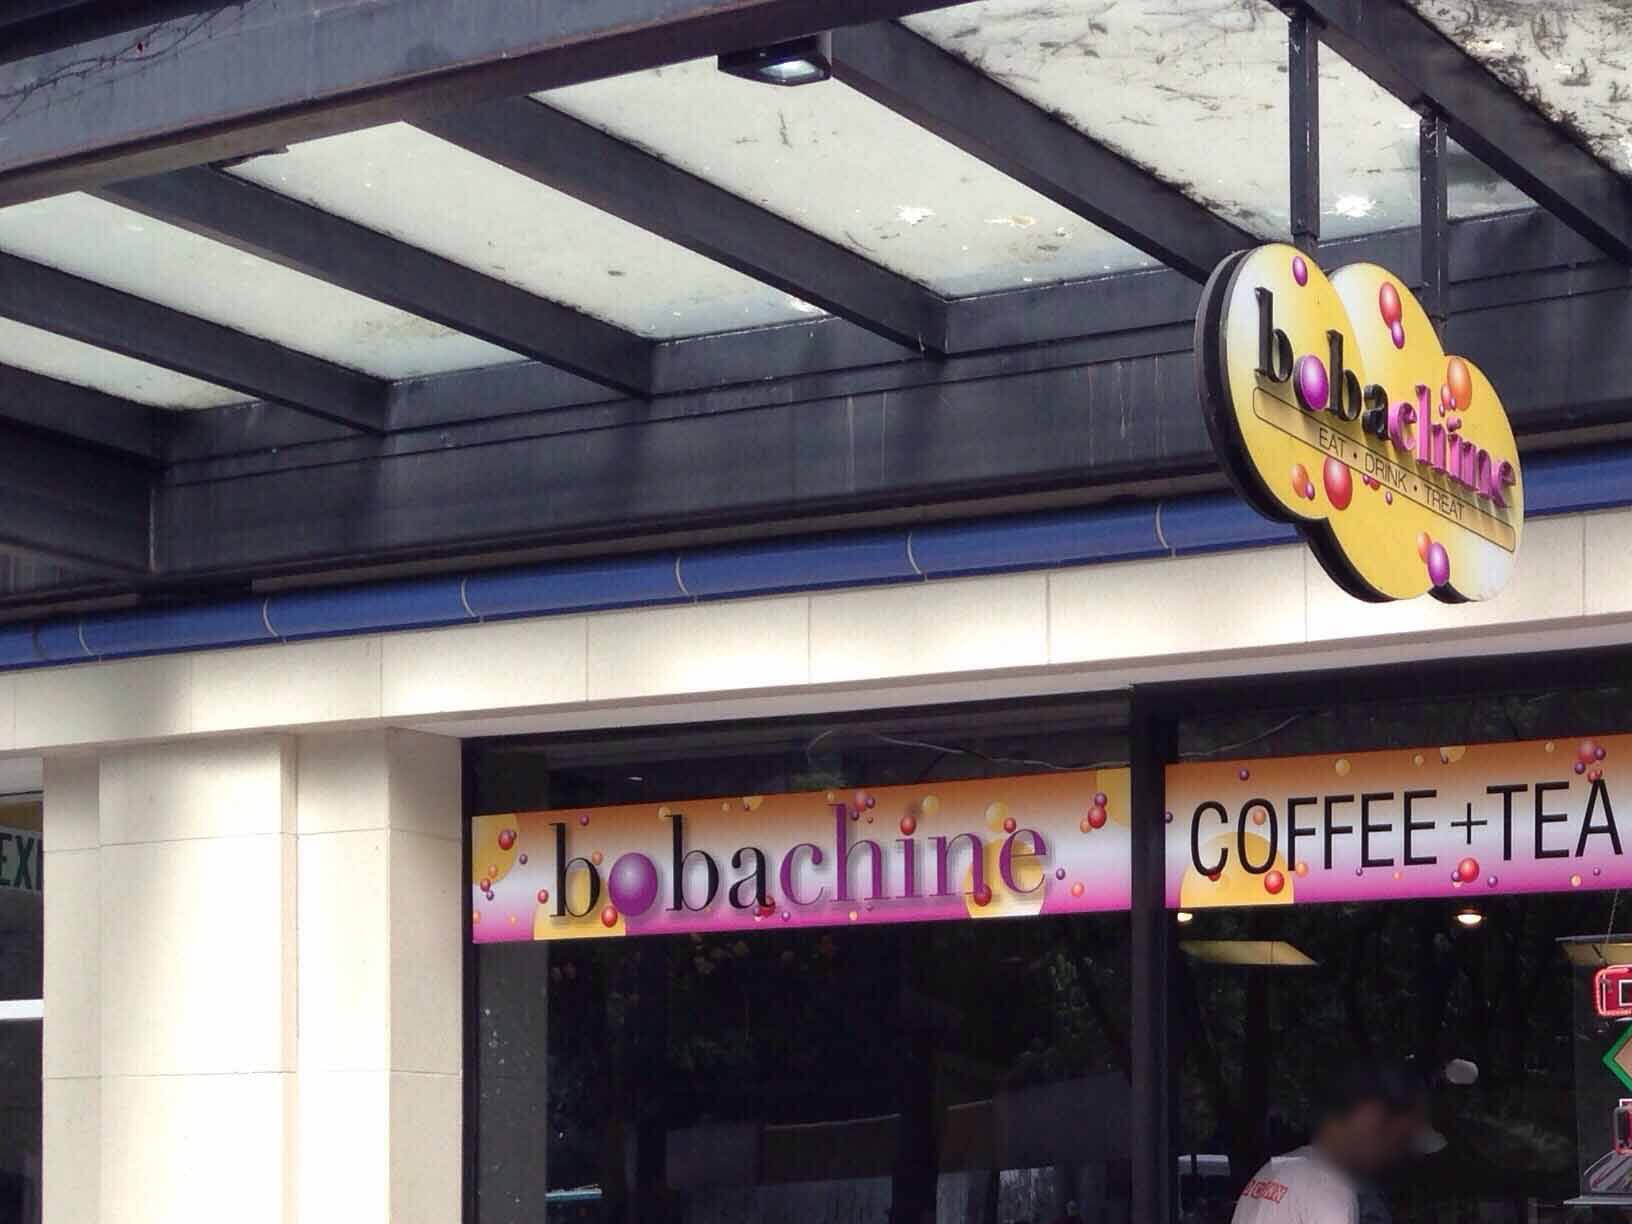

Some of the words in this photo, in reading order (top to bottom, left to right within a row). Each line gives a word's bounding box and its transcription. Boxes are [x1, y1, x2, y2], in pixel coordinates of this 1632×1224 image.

[1254, 287, 1517, 508] bobachine
[1319, 426, 1346, 457] EAT
[1364, 454, 1408, 494] DRINK
[1424, 484, 1465, 521] TREAT
[550, 802, 1048, 918] bobachine
